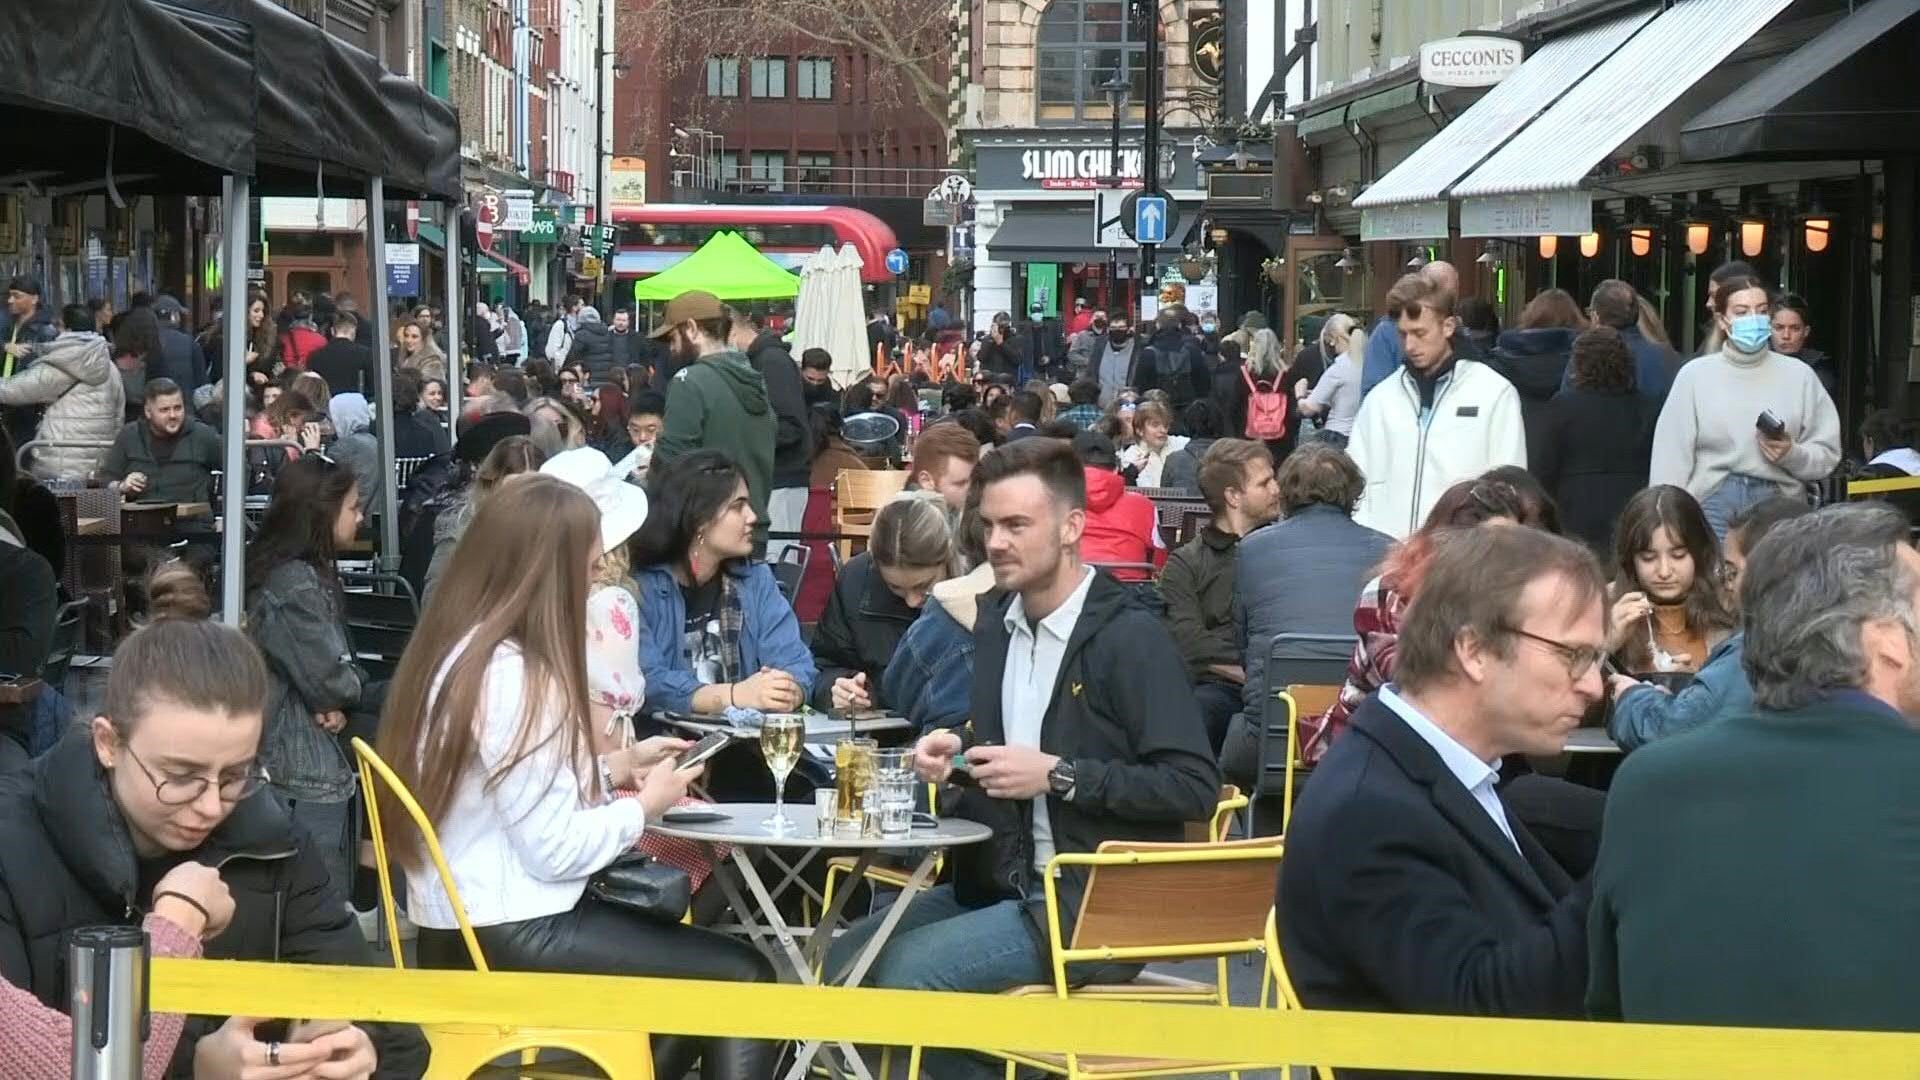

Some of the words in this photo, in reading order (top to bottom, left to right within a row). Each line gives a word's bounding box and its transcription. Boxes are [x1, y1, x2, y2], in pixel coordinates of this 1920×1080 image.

[1431, 48, 1514, 67] CECCONI'S
[1022, 149, 1075, 180] SLIM
[1078, 149, 1176, 180] CHICK
